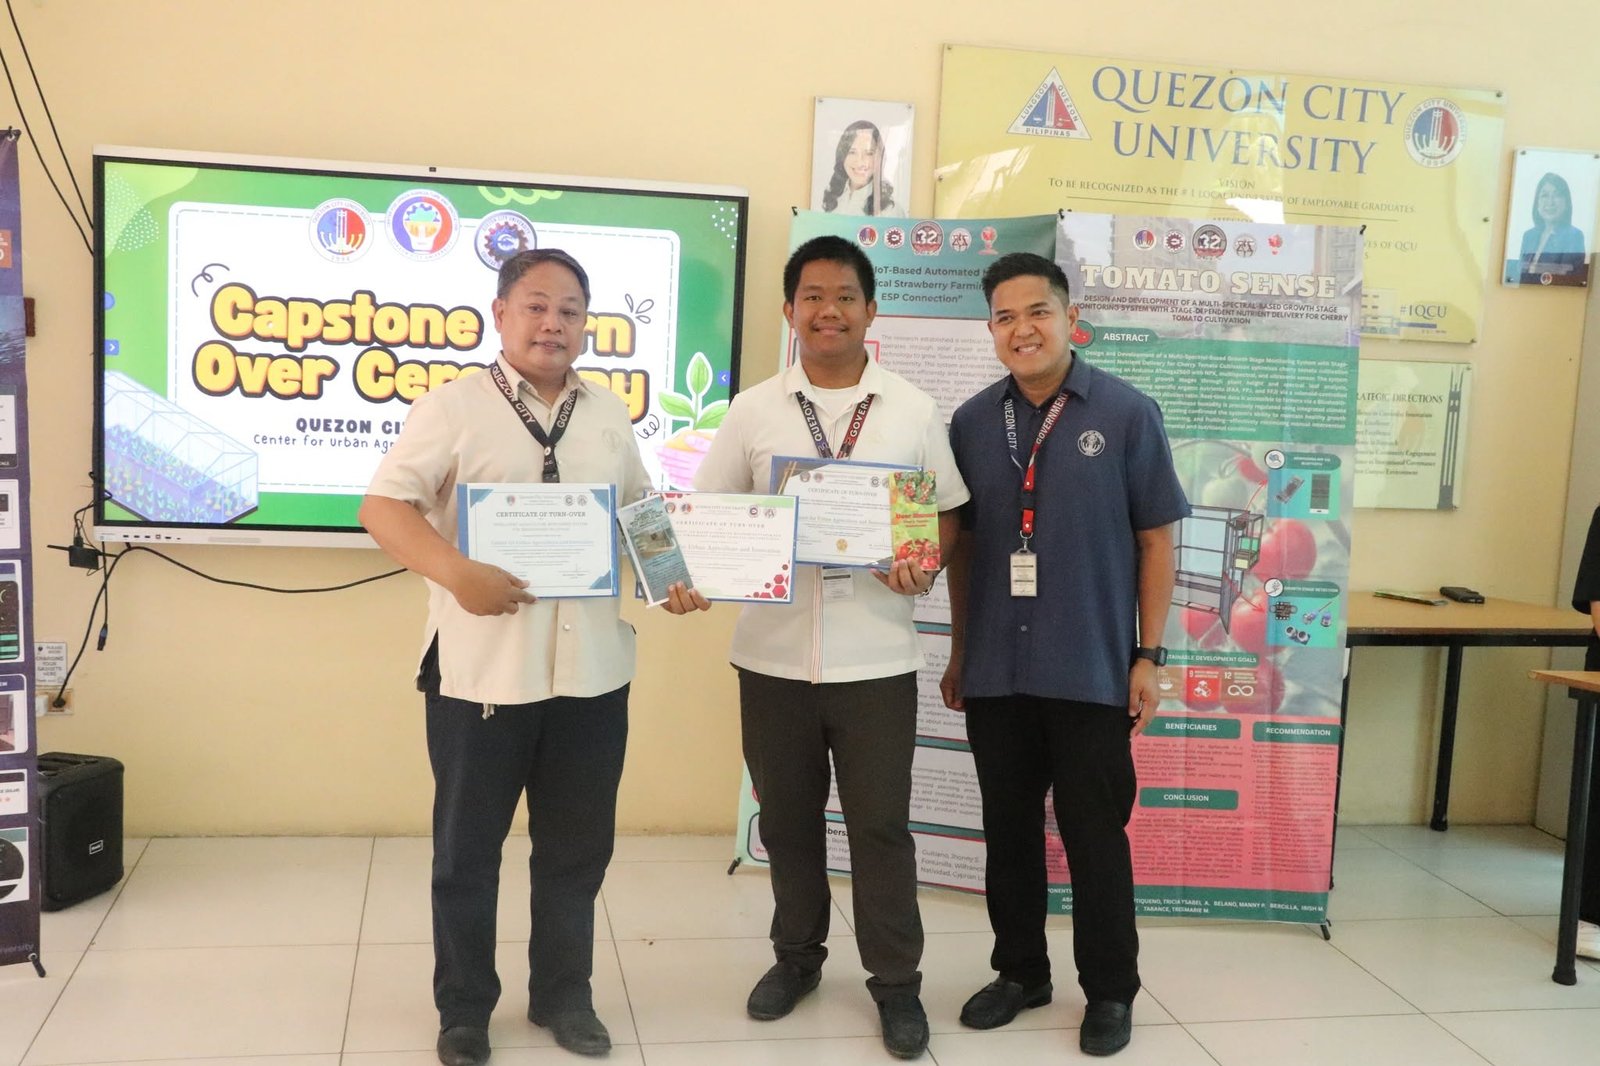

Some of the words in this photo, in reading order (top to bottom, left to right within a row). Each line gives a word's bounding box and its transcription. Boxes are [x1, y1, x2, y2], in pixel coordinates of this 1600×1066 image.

[1021, 82, 1049, 119] LUNGSOD
[1058, 84, 1079, 122] QUEZON
[1092, 66, 1290, 115] QUEZON
[1303, 84, 1406, 124] CITY
[1026, 128, 1071, 137] PILIPINAS
[1112, 121, 1376, 174] UNIVERSITY
[1218, 178, 1255, 189] VISION
[1049, 178, 1062, 188] TO
[1066, 180, 1077, 189] BE
[1080, 180, 1143, 193] RECOGNIZED
[1146, 186, 1157, 194] AS
[1160, 187, 1177, 196] THE
[1288, 196, 1299, 205] OF
[1302, 198, 1359, 210] EMPLOYABLE
[924, 268, 980, 277] Automated
[1080, 264, 1221, 293] TOMATO
[1231, 271, 1337, 299] SENSE
[874, 280, 892, 288] ical
[895, 280, 947, 291] Strawberry
[951, 282, 984, 291] Farmin
[882, 293, 899, 301] ESP
[1084, 295, 1110, 303] DESIGN
[1111, 296, 1127, 304] AND
[1128, 297, 1180, 306] DEVELOPMENT
[1198, 300, 1282, 312] MULTI-SPECTRAL-BASED
[1283, 304, 1315, 312] GROWTH
[1316, 306, 1338, 314] STAGE
[210, 281, 484, 350] Capstone
[1121, 304, 1149, 312] SYSTEM
[1170, 306, 1235, 316] STAGE-DEPENDENT
[1236, 310, 1271, 318] NUTRIENT
[1306, 312, 1319, 320] FOR
[1320, 314, 1349, 322] CHERRY
[1204, 316, 1251, 324] CULTIVATION
[1103, 333, 1149, 342] ABSTRACT
[192, 340, 340, 401] Over
[352, 347, 650, 424] Cerny
[492, 366, 516, 402] QUEZON
[516, 401, 536, 424] CITY
[1356, 392, 1389, 401] RATEGIC
[1392, 394, 1444, 404] DIRECTIONS
[801, 400, 823, 442] QUEZON
[1004, 398, 1016, 430] QUEZON
[1036, 392, 1069, 445] GOVERNMENT
[296, 418, 372, 434] QUEZON
[381, 420, 405, 435] CI
[254, 434, 297, 446] Center
[304, 434, 324, 446] for
[374, 439, 395, 454] Agr
[1008, 432, 1018, 450] CITY
[1166, 722, 1217, 732] BENEFICIARIES
[1266, 727, 1331, 737] RECOMMENDATION
[1164, 793, 1210, 802] CONCLUSION
[828, 827, 849, 837] bers:
